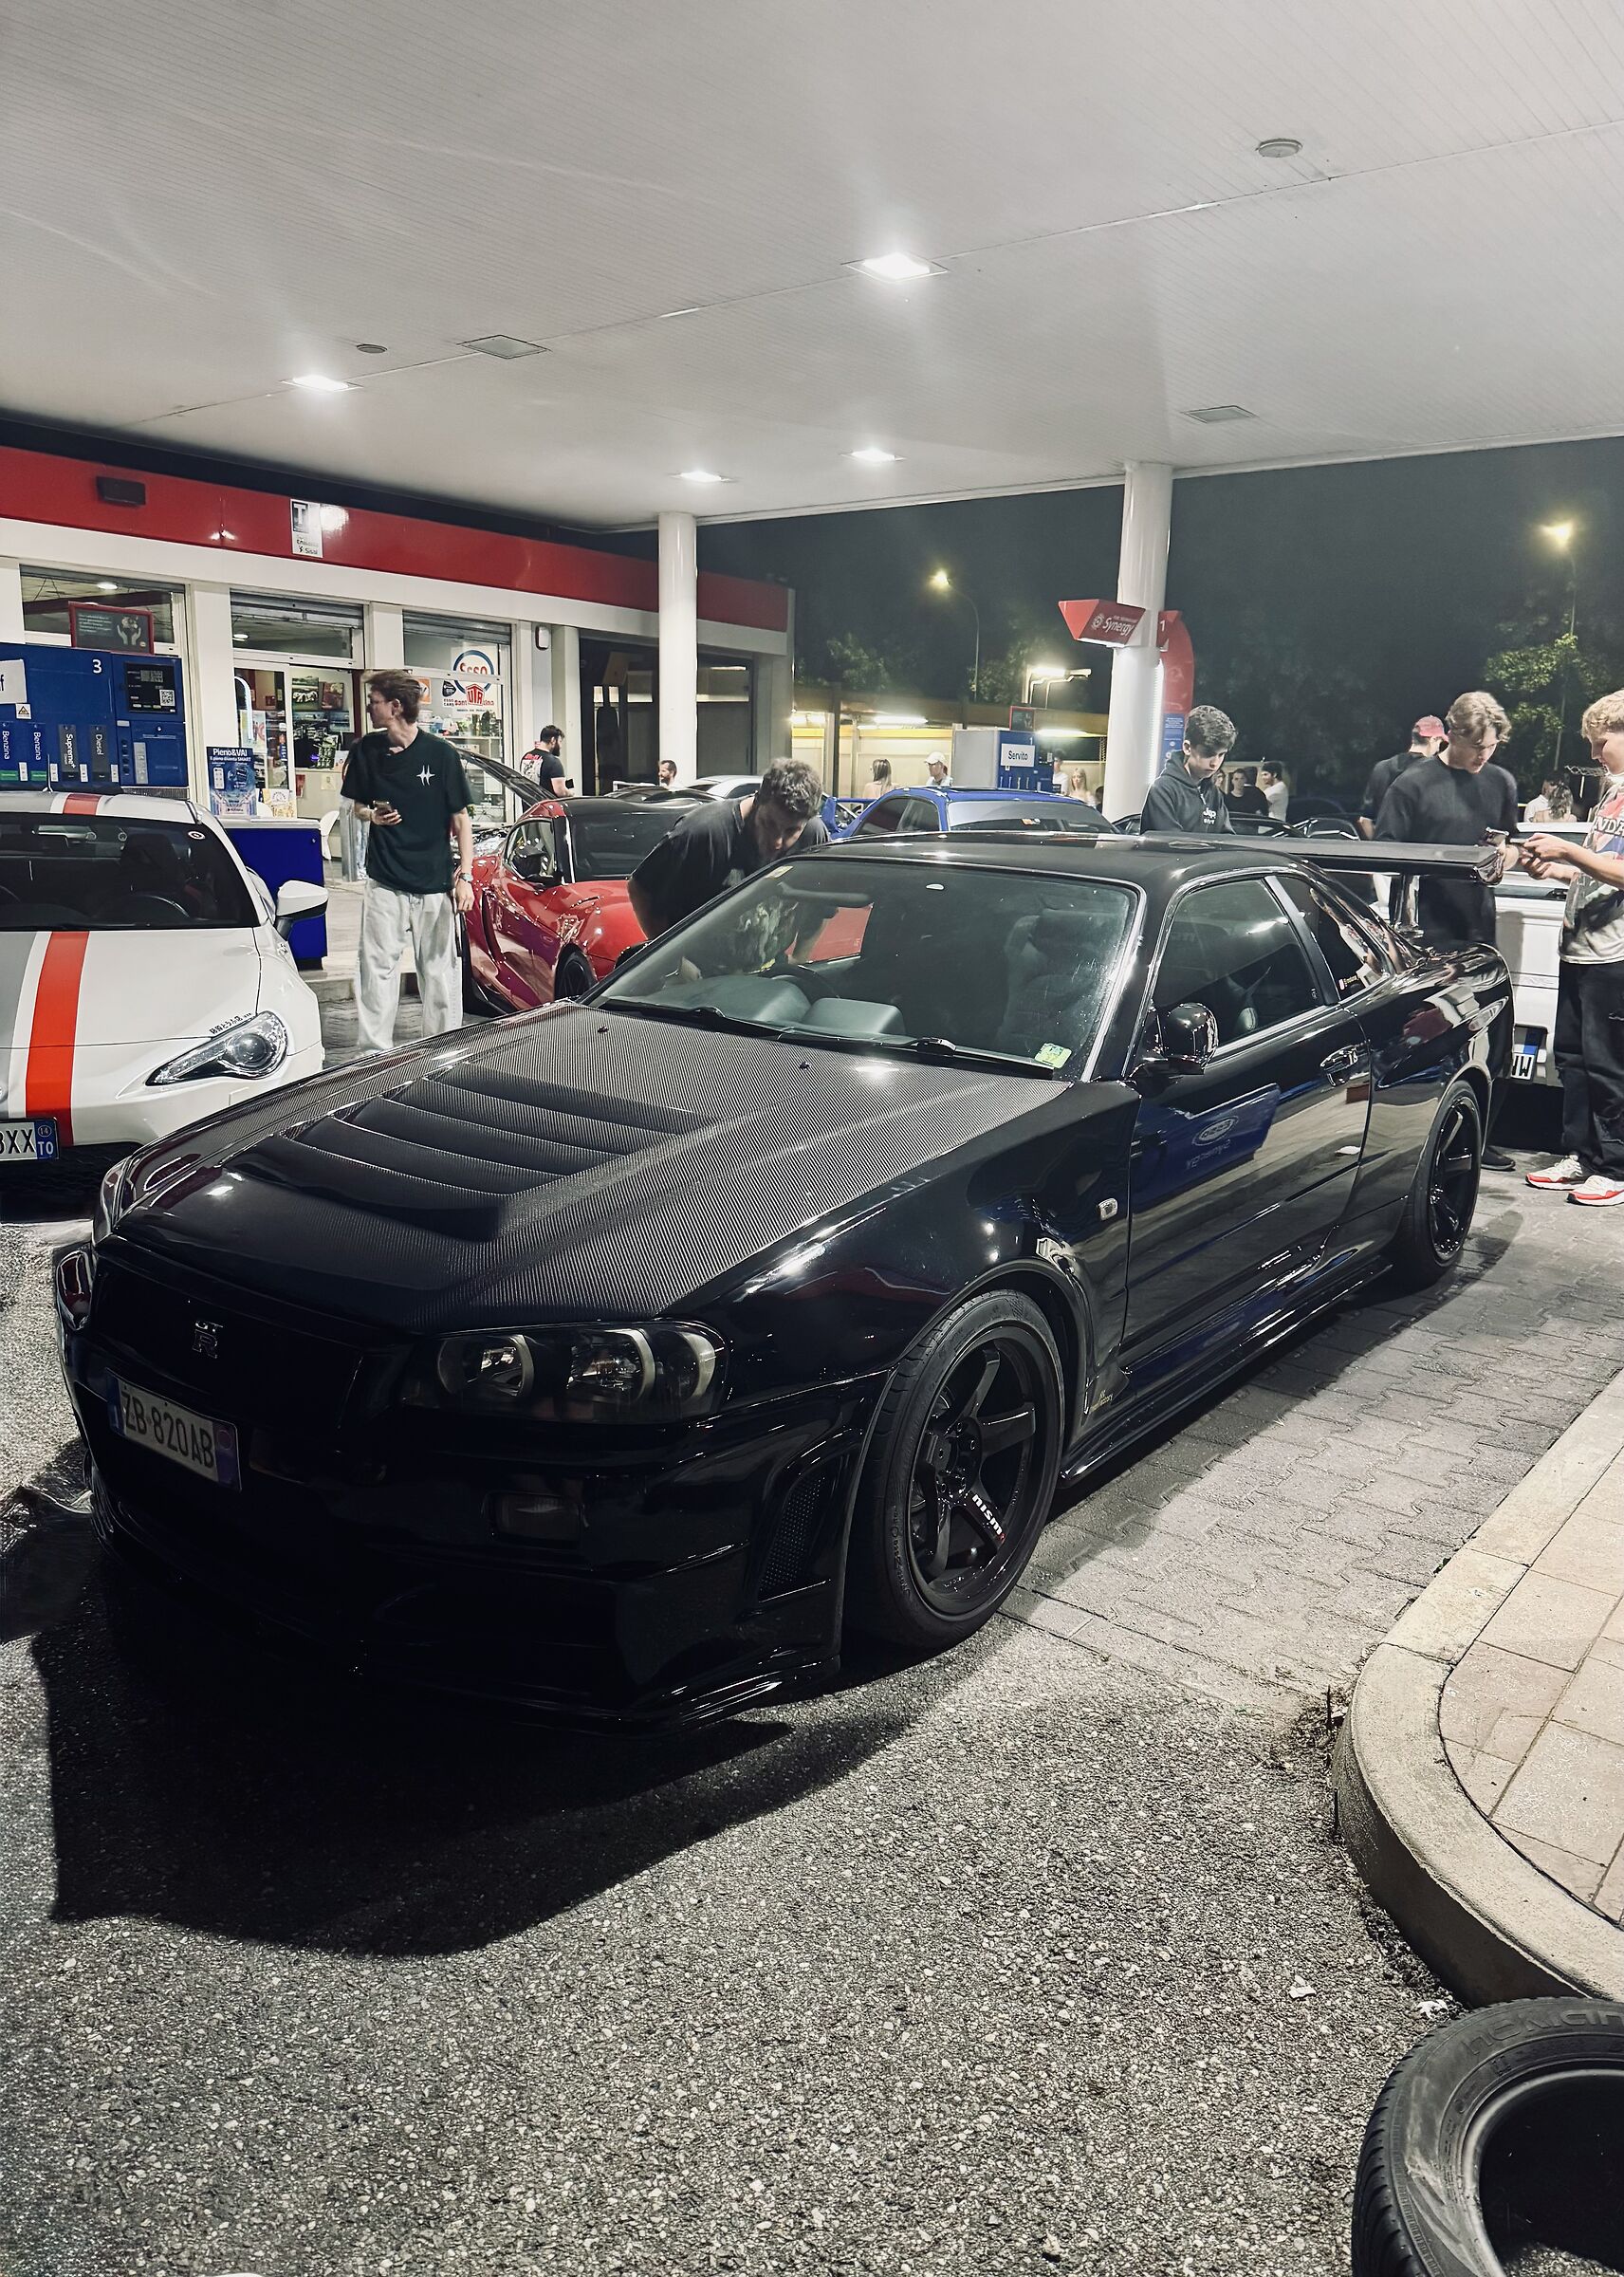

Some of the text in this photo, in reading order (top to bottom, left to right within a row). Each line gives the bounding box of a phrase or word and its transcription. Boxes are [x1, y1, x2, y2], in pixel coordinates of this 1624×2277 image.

[1102, 617, 1135, 636] Synergy
[1159, 620, 1166, 632] 1
[92, 659, 102, 674] 3
[2, 731, 10, 760] Benzina
[33, 731, 42, 761] Benzina
[96, 733, 104, 755] Diesel
[212, 748, 248, 757] Pieno&VAI
[1007, 750, 1029, 761] Servito
[38, 1140, 54, 1156] TO
[192, 1328, 218, 1360] R
[120, 1391, 215, 1469] ZB 820AB
